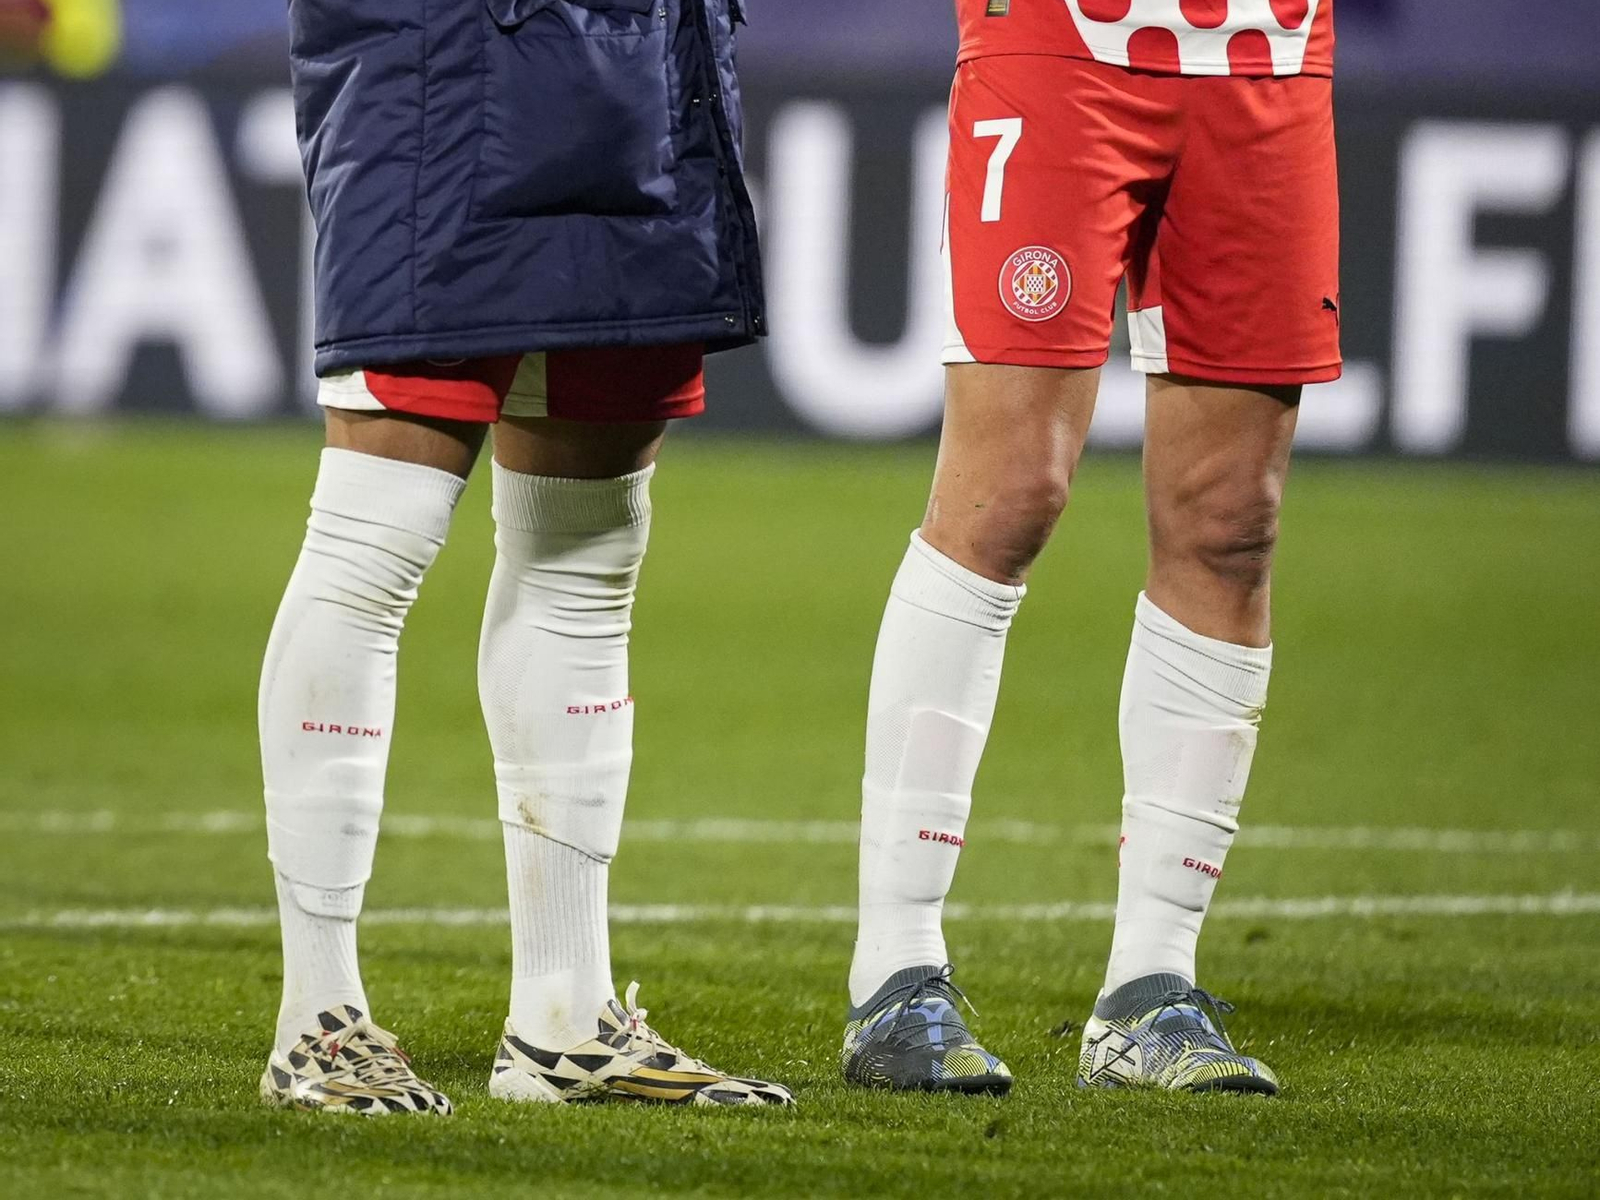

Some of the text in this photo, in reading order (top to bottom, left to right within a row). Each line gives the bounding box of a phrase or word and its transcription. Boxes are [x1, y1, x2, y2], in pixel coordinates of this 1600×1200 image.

[972, 117, 1023, 222] 7
[1012, 250, 1058, 268] GIRONA
[1012, 301, 1058, 315] FUTBOL CLUB
[302, 721, 382, 737] GIRONA
